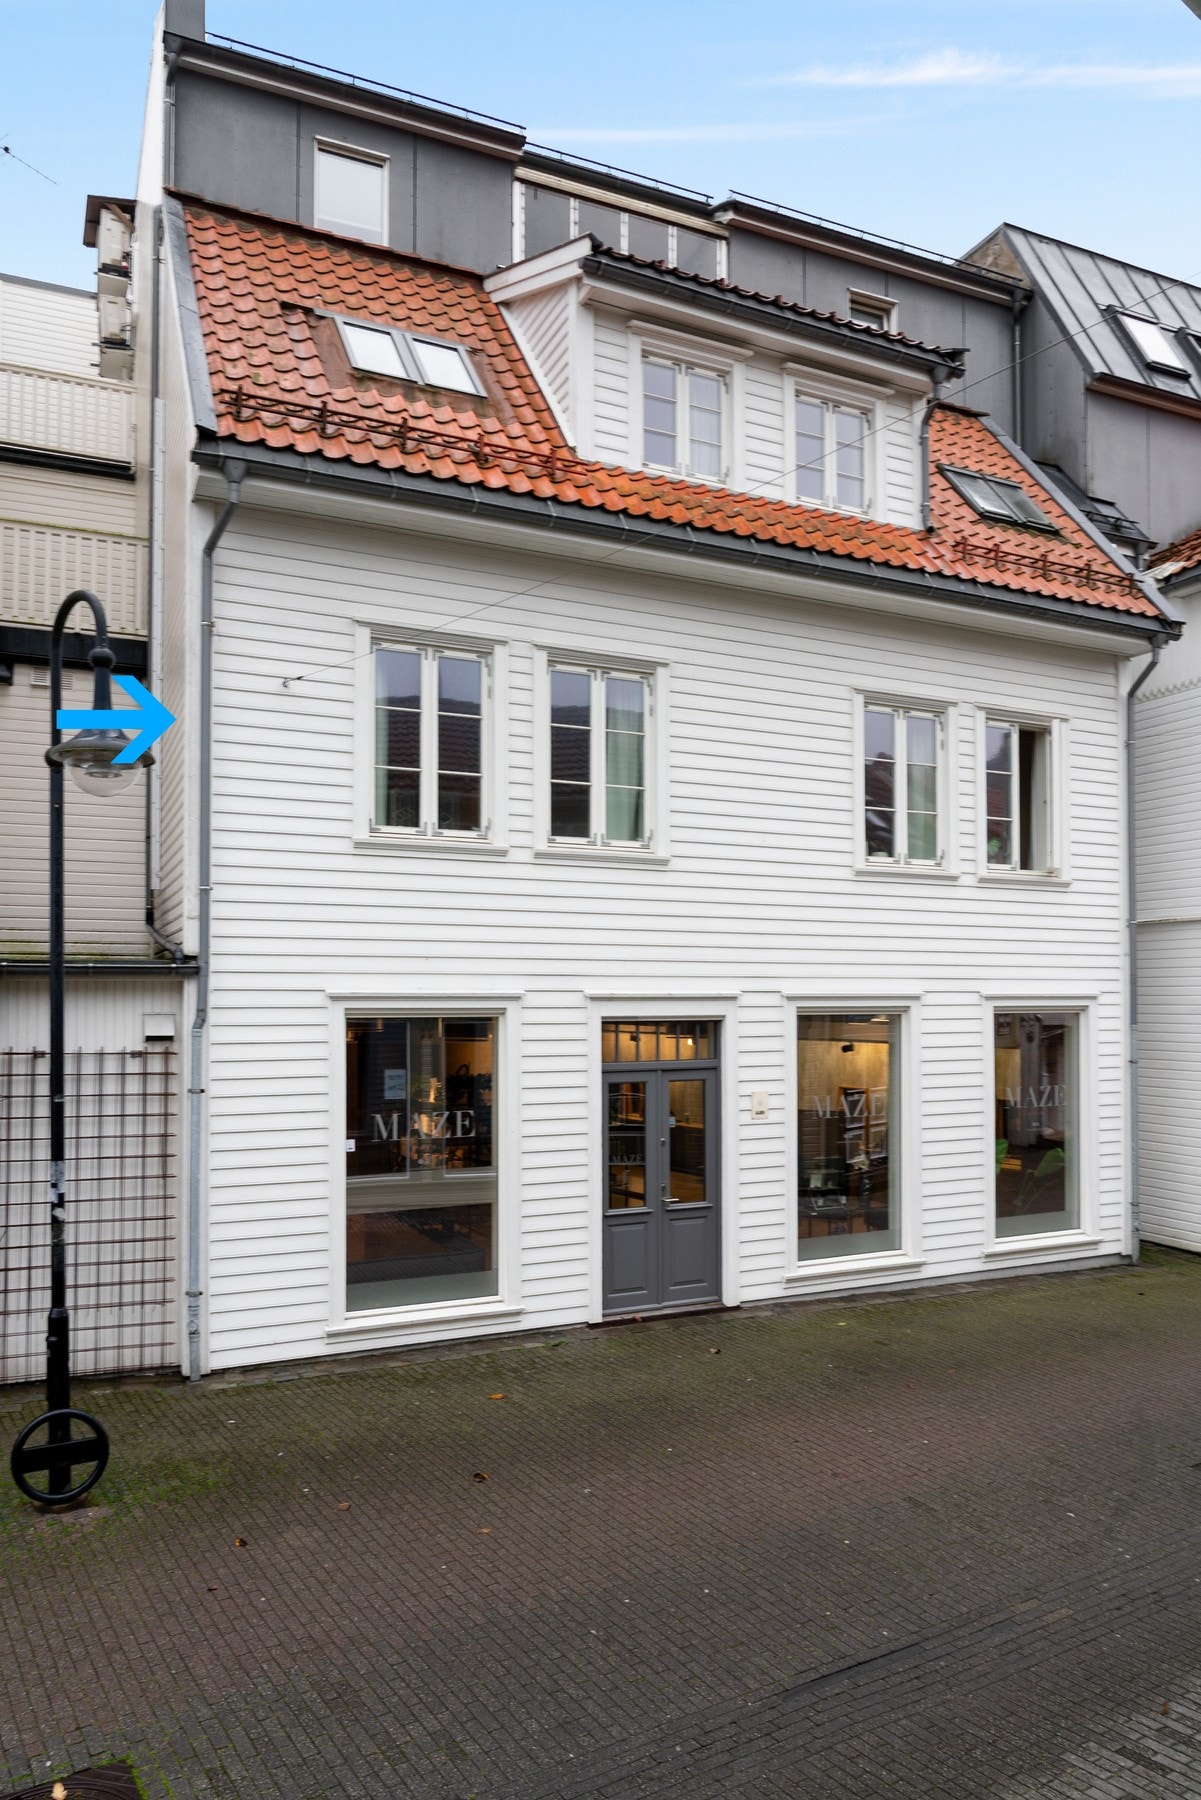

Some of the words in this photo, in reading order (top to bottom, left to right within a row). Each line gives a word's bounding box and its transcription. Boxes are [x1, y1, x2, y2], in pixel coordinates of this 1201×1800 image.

[811, 1093, 887, 1119] MAZE
[1003, 1085, 1067, 1109] MAZE
[371, 1110, 476, 1142] MAZE
